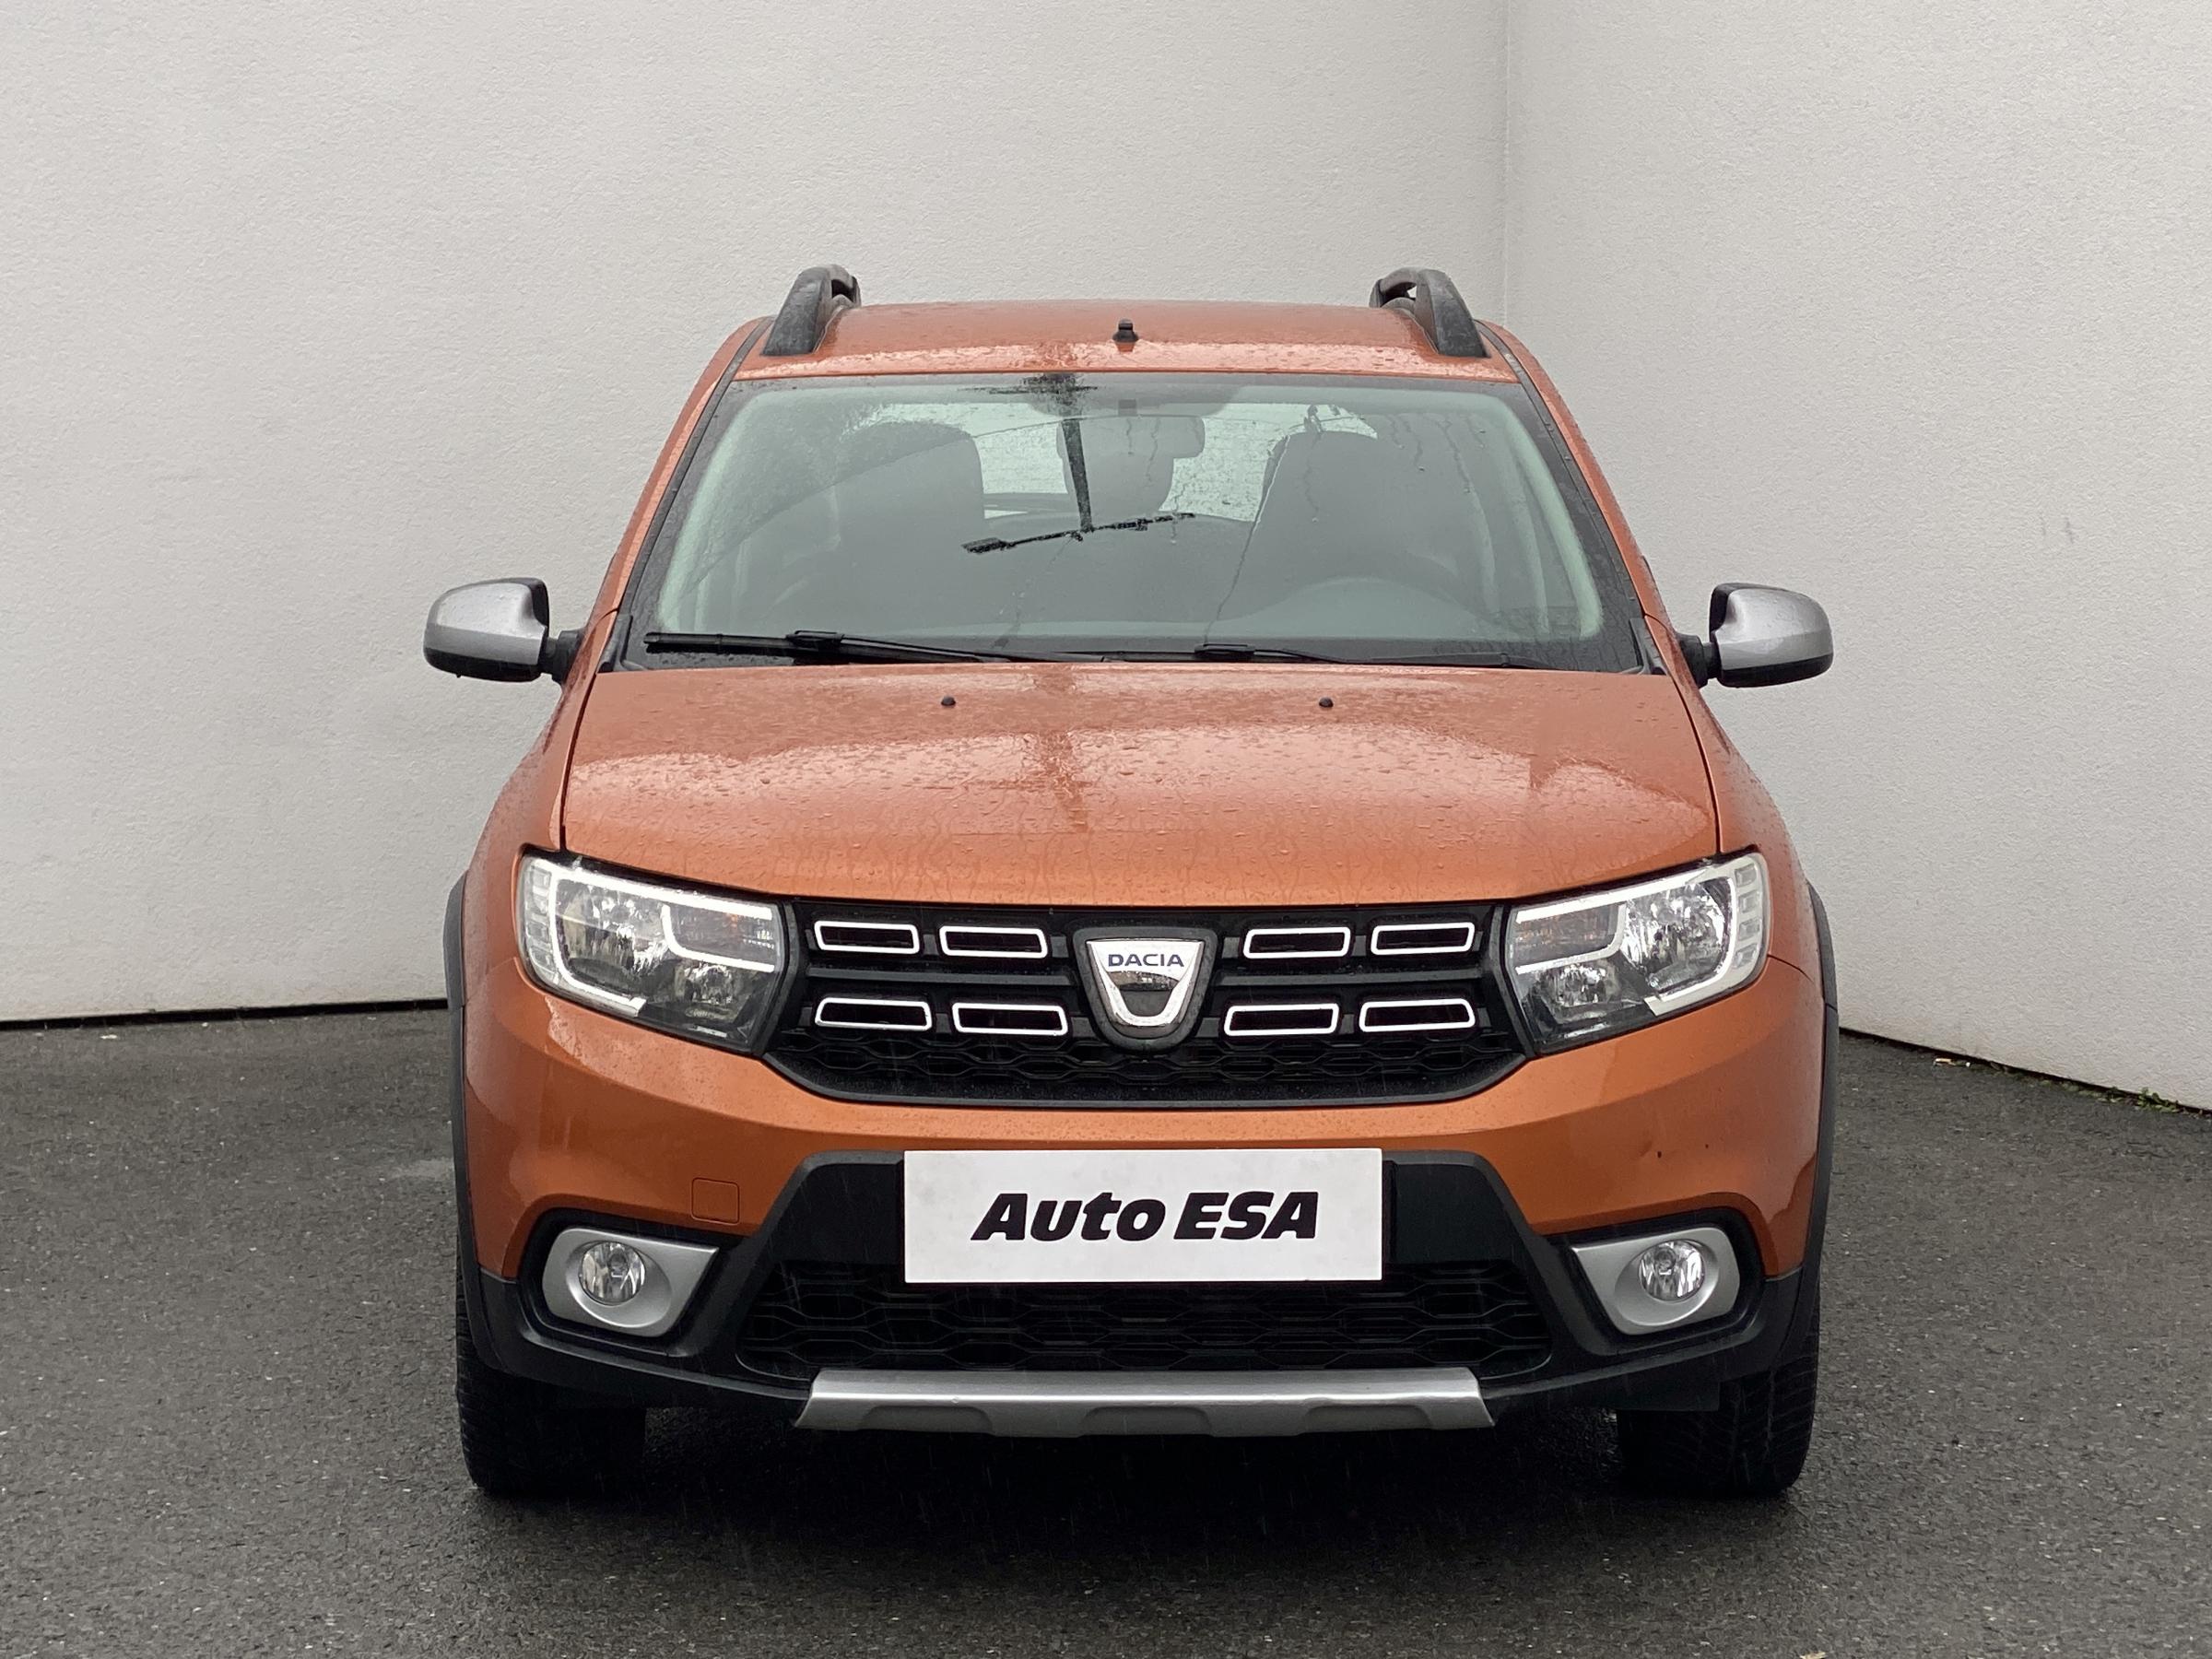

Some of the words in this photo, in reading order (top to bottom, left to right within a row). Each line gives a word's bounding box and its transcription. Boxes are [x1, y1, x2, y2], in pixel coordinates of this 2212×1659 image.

[1108, 953, 1184, 968] DACIA
[970, 1192, 1166, 1241] Auto
[1173, 1191, 1319, 1241] ESA
